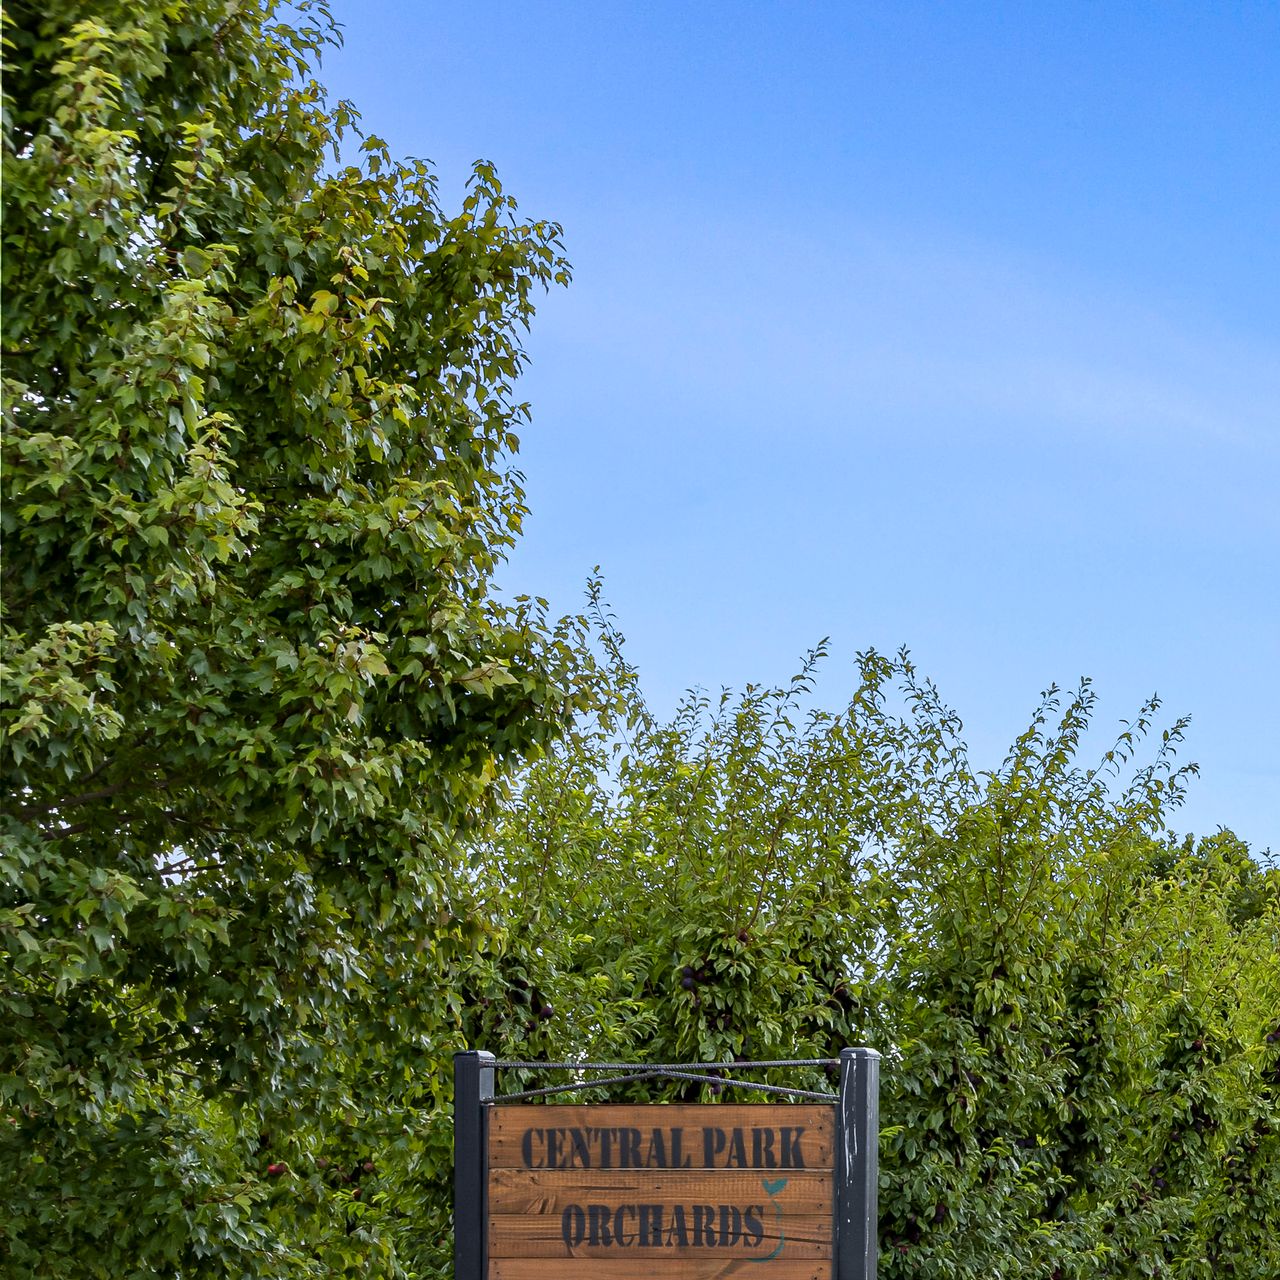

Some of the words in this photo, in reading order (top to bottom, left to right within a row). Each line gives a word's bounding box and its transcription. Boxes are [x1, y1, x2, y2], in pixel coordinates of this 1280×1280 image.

[521, 1126, 691, 1169] CENTRAL
[702, 1126, 807, 1169] PARK
[561, 1203, 765, 1248] ORCHARDS
